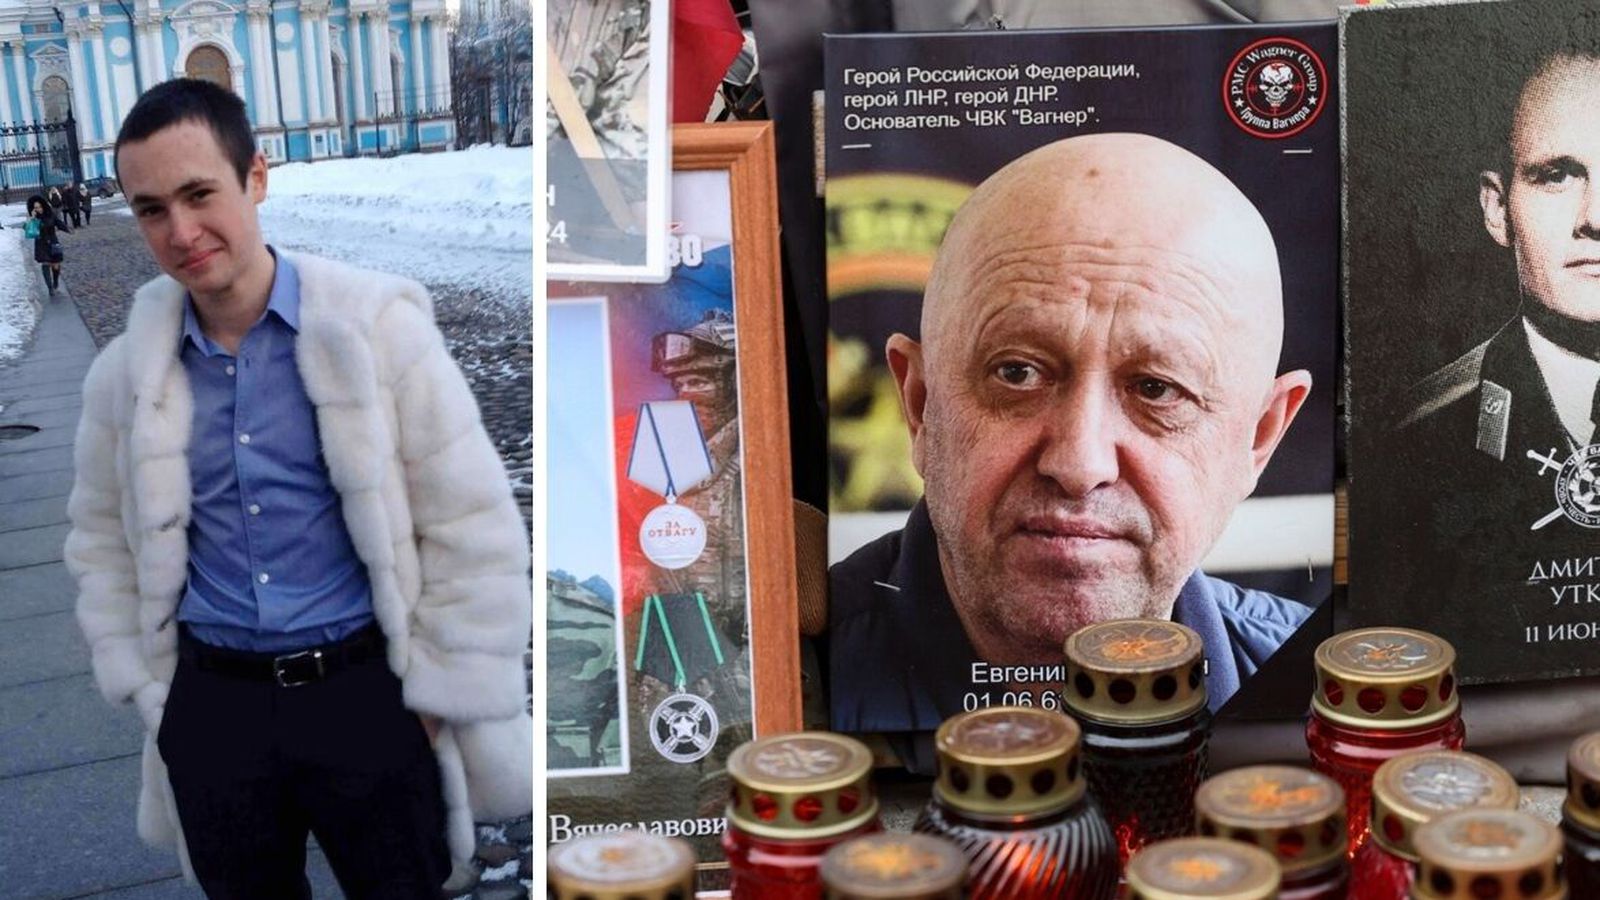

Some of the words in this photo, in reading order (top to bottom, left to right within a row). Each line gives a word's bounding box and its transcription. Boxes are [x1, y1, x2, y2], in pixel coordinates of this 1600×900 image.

[844, 67, 901, 88] Герой
[906, 64, 1020, 84] Российской
[1025, 63, 1140, 82] Федерации,
[1231, 61, 1250, 96] PMC
[1246, 46, 1299, 64] Wagner
[1297, 53, 1318, 92] Group
[844, 90, 898, 111] герой
[903, 88, 949, 107] ЛНР,
[954, 86, 1009, 108] герой
[1013, 85, 1060, 106] ДНР.
[844, 113, 961, 131] Основатель
[965, 109, 1007, 127] ЧВК
[1240, 106, 1272, 129] Группа
[1272, 105, 1311, 129] Вагнера
[971, 662, 1066, 684] Евгени
